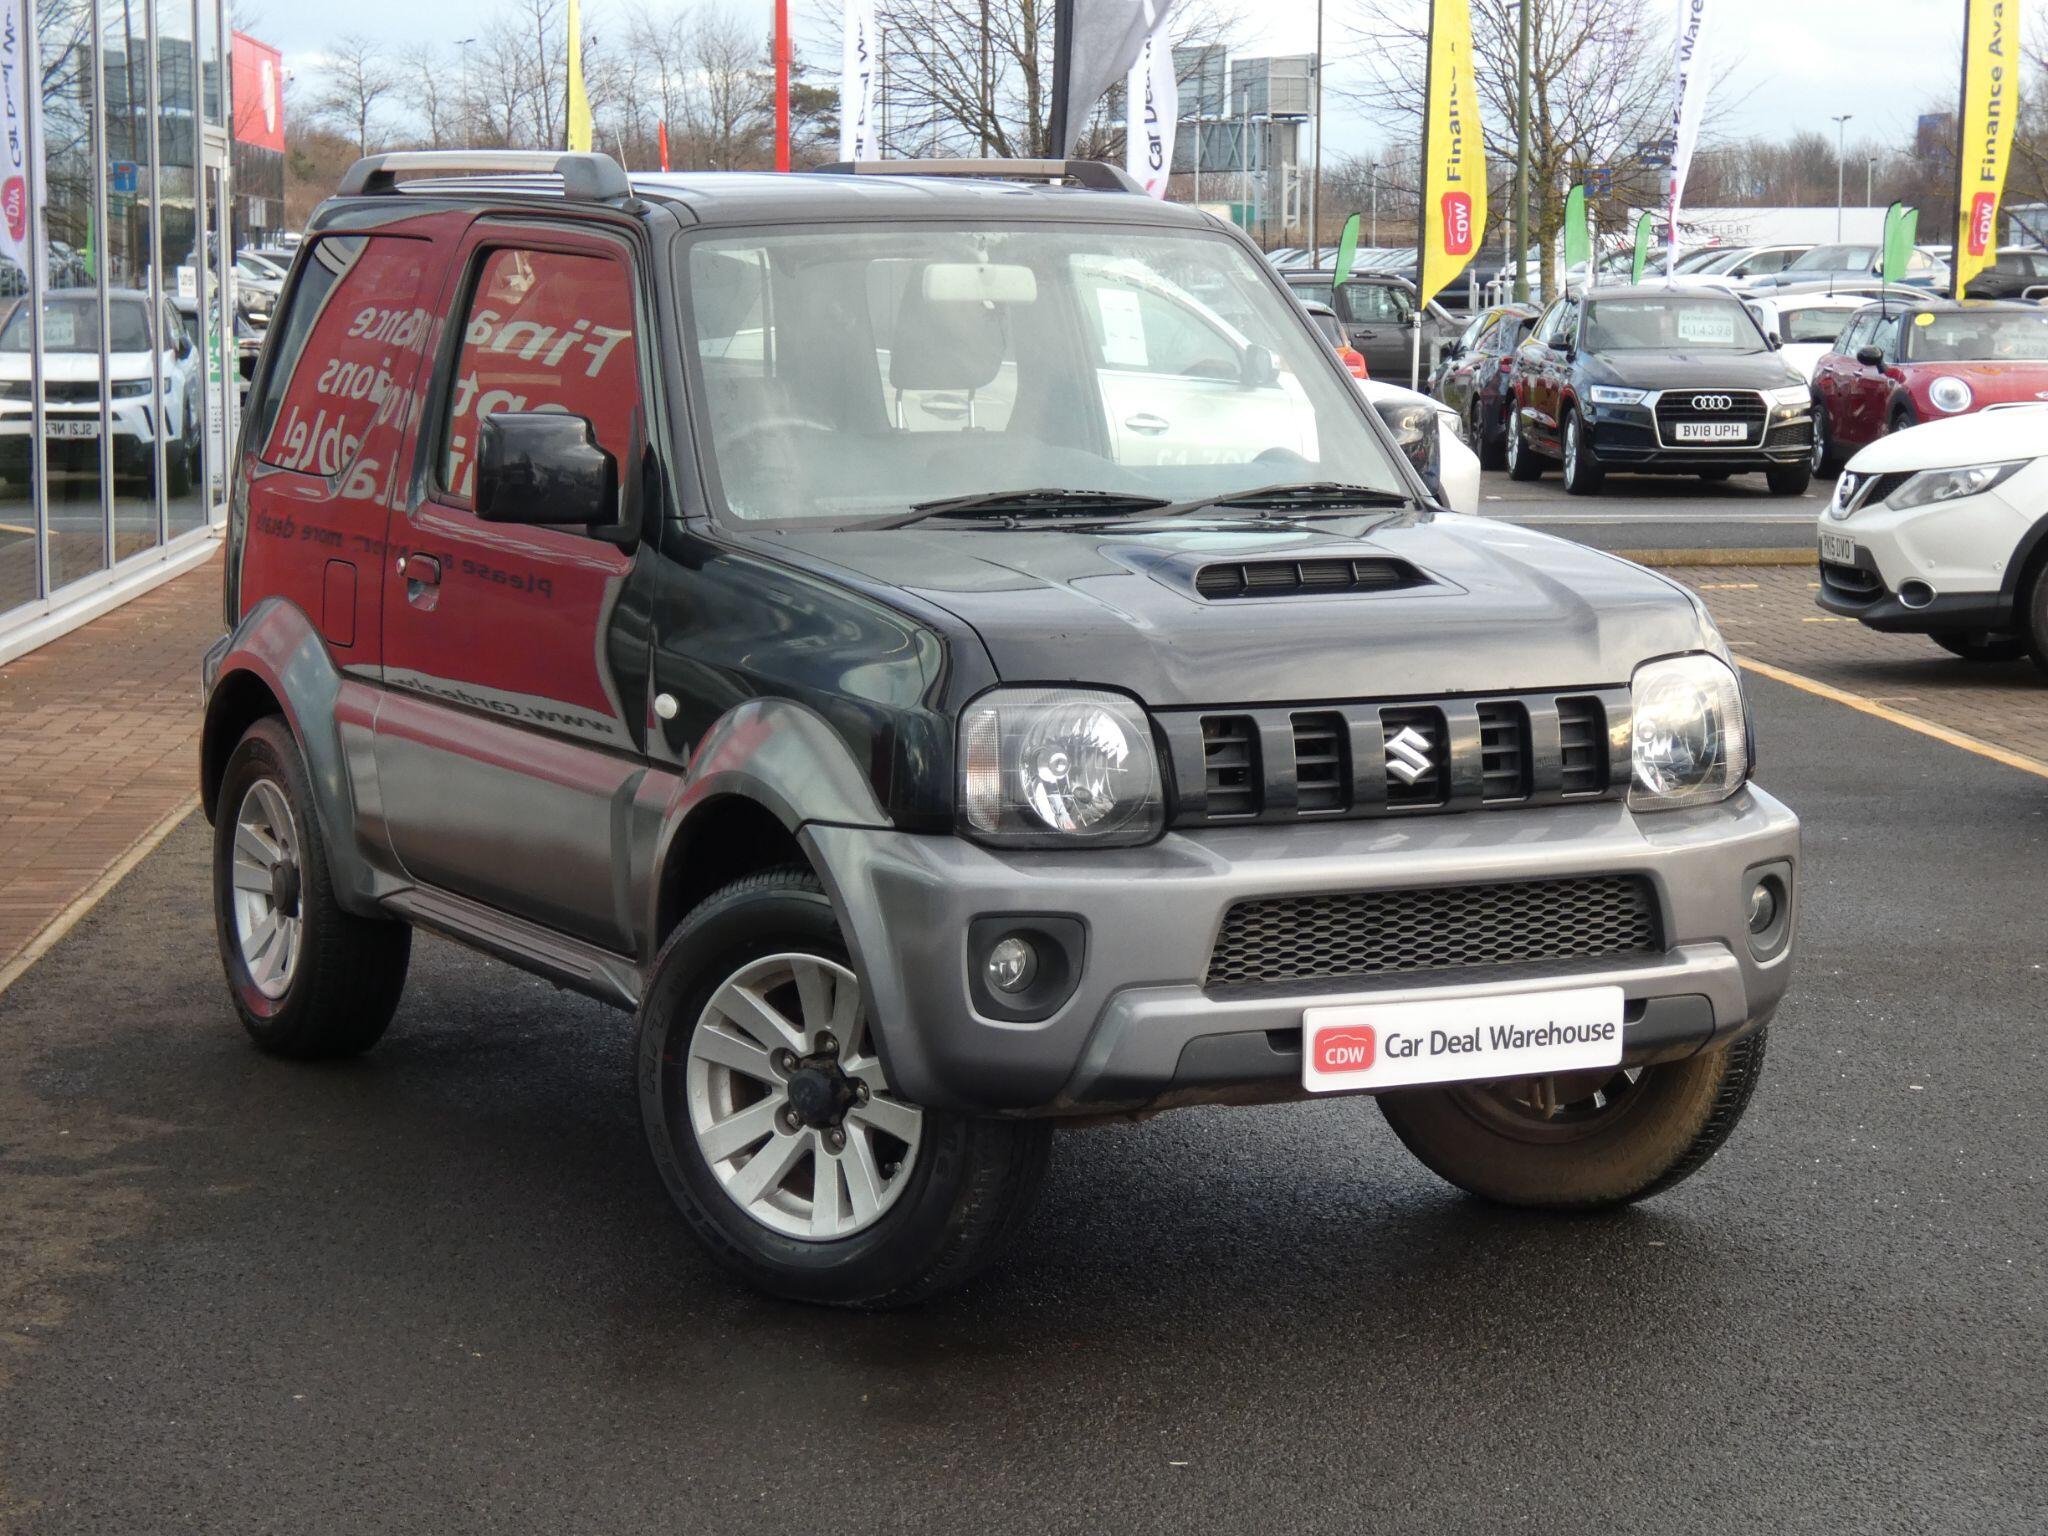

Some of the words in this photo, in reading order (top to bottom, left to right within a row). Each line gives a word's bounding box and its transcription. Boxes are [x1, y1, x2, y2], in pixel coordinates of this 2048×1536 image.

[1981, 66, 2004, 182] Finance
[1149, 131, 1163, 171] Car
[1455, 202, 1470, 244] CDW
[1979, 202, 1994, 244] CDW
[1683, 425, 1711, 437] BV18
[1714, 425, 1740, 437] UPH
[1325, 1046, 1366, 1066] CDW
[1384, 1032, 1424, 1060] Car
[1430, 1026, 1483, 1056] Deal
[1490, 1020, 1616, 1051] Warehouse
